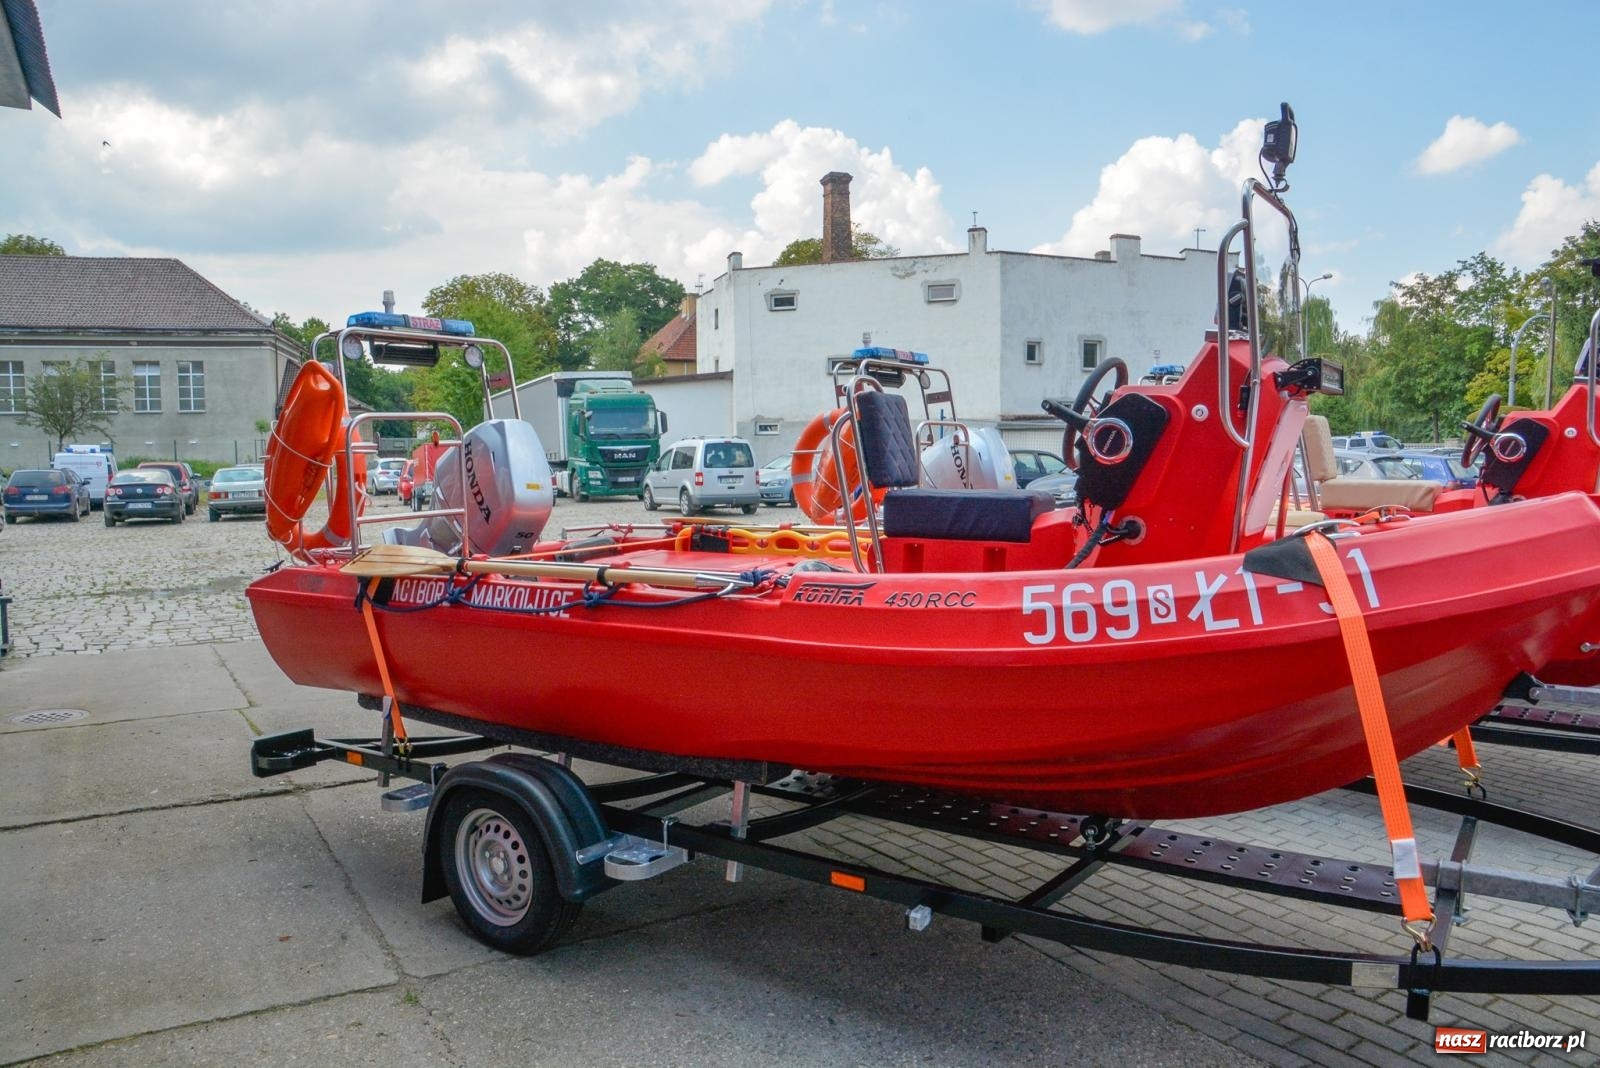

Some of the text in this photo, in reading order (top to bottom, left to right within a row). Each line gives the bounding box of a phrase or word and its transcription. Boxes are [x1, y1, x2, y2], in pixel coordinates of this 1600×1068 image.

[464, 440, 492, 525] HONDA
[515, 531, 534, 539] 50
[470, 583, 574, 618] MARKOWICE
[1022, 579, 1139, 645] 569
